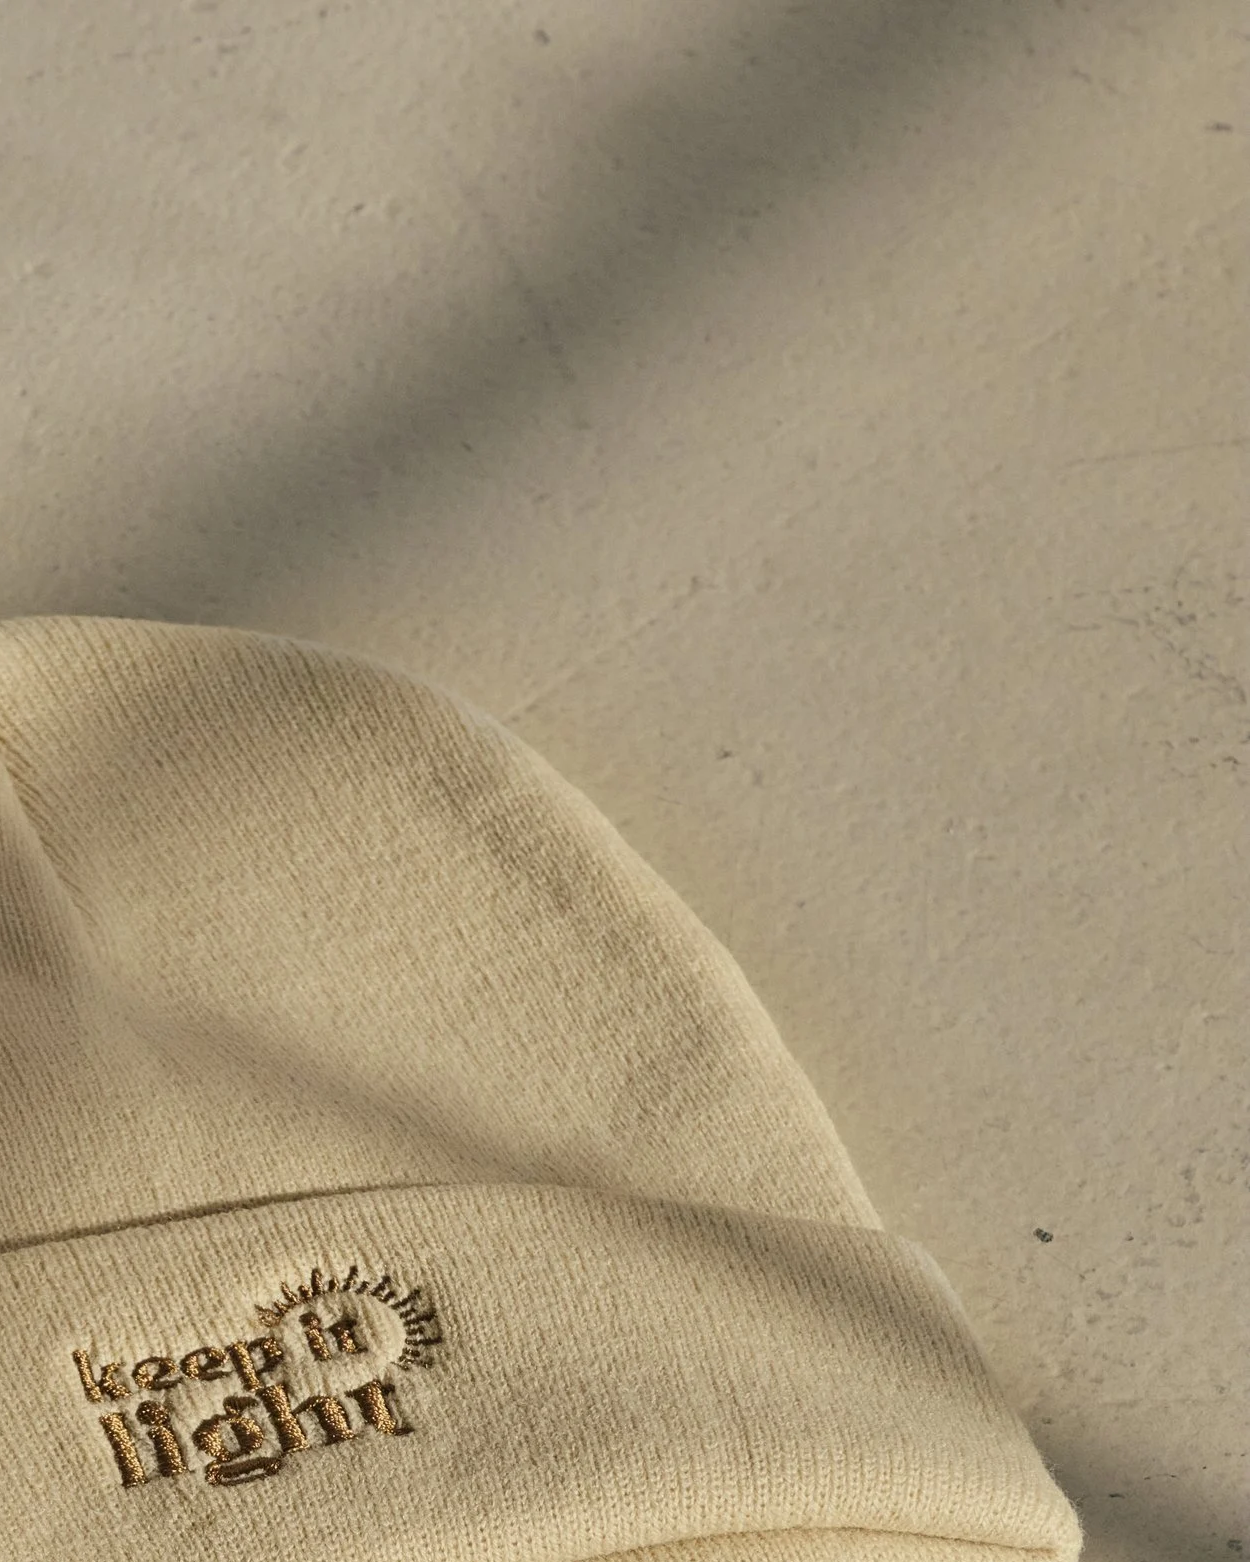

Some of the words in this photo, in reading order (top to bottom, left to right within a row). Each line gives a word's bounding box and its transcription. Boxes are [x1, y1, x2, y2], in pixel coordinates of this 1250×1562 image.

[71, 1338, 285, 1403] keep
[299, 1311, 369, 1362] it
[99, 1379, 416, 1488] light
